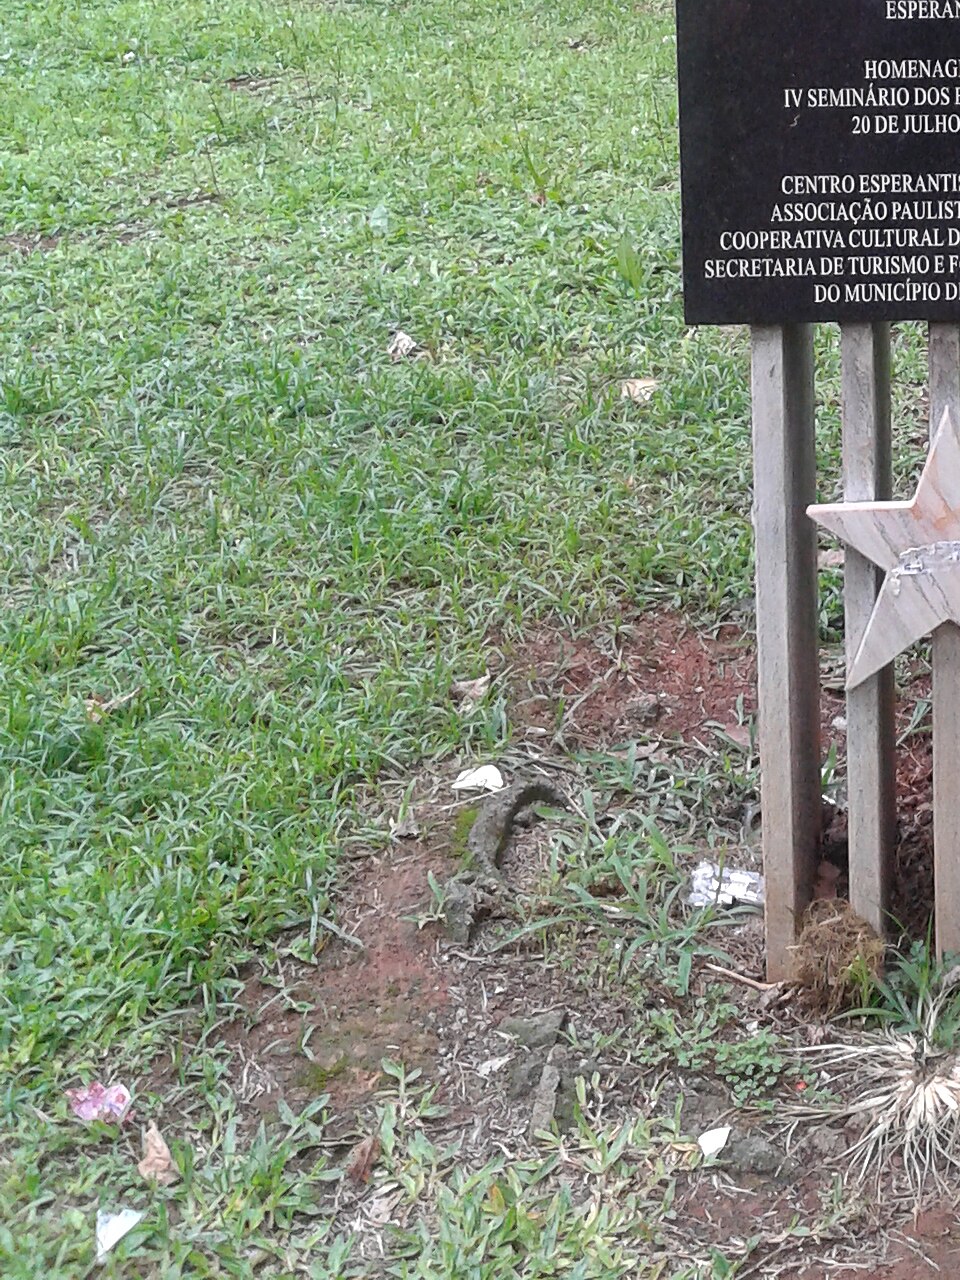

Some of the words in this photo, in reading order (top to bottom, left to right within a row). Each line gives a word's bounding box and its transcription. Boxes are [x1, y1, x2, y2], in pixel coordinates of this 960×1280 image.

[784, 88, 803, 108] IV
[807, 82, 910, 108] SEMINÁRIO
[913, 86, 950, 106] DOS
[851, 115, 871, 135] 20
[874, 114, 899, 134] DE
[902, 113, 960, 134] JULHO
[781, 174, 855, 195] CENTRO
[770, 197, 888, 226] ASSOCIAÇÃO
[719, 229, 845, 251] COOPERATIVA
[848, 227, 945, 249] CULTURAL
[704, 257, 817, 279] SECRETARIA
[820, 256, 845, 276] DE
[847, 254, 930, 276] TURISMO
[933, 254, 945, 274] E
[813, 283, 841, 303] DO
[844, 277, 941, 303] MUNICÍPIO
